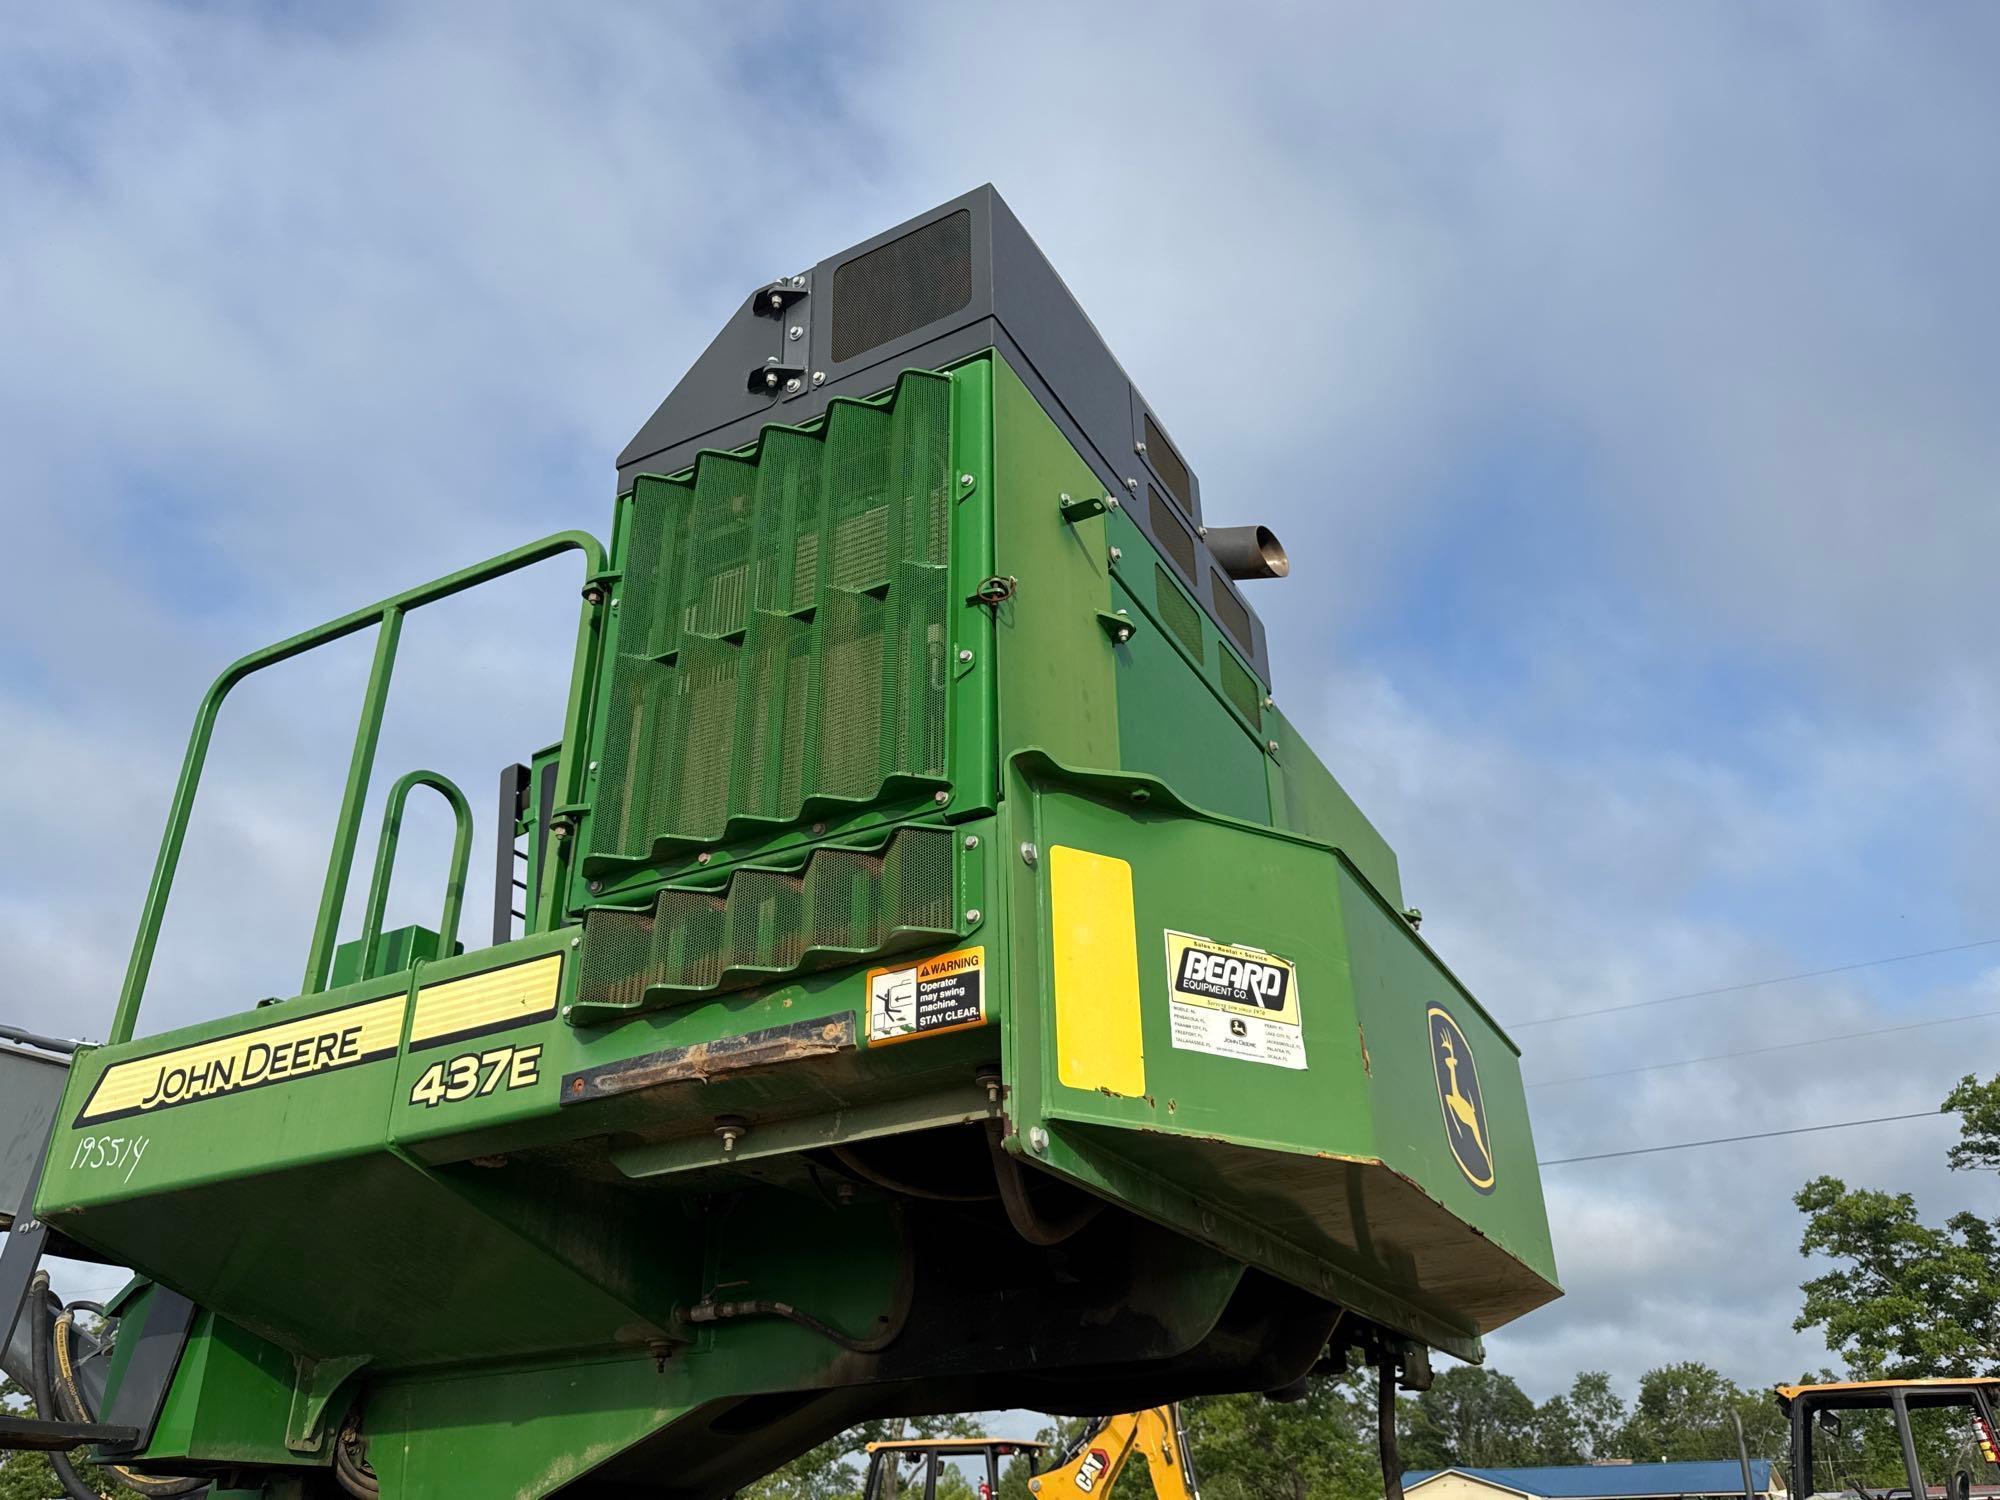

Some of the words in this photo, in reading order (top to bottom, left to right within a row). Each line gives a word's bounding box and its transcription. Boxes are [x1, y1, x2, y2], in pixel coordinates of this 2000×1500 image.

[931, 955, 979, 974] WARNING
[920, 978, 957, 992] Operator
[1183, 979, 1232, 996] EQUIPMENT
[1233, 989, 1249, 999] CO.
[1184, 950, 1281, 1008] BEARD
[920, 992, 938, 1002] may
[939, 987, 965, 998] swing
[920, 999, 958, 1012] machine.
[919, 1013, 944, 1026] STAY
[945, 1006, 979, 1020] CLEAR.
[142, 1055, 237, 1105] JOHN
[241, 1026, 363, 1082] DEERE
[410, 1044, 543, 1108] 437E
[1075, 1453, 1104, 1493] CAT
